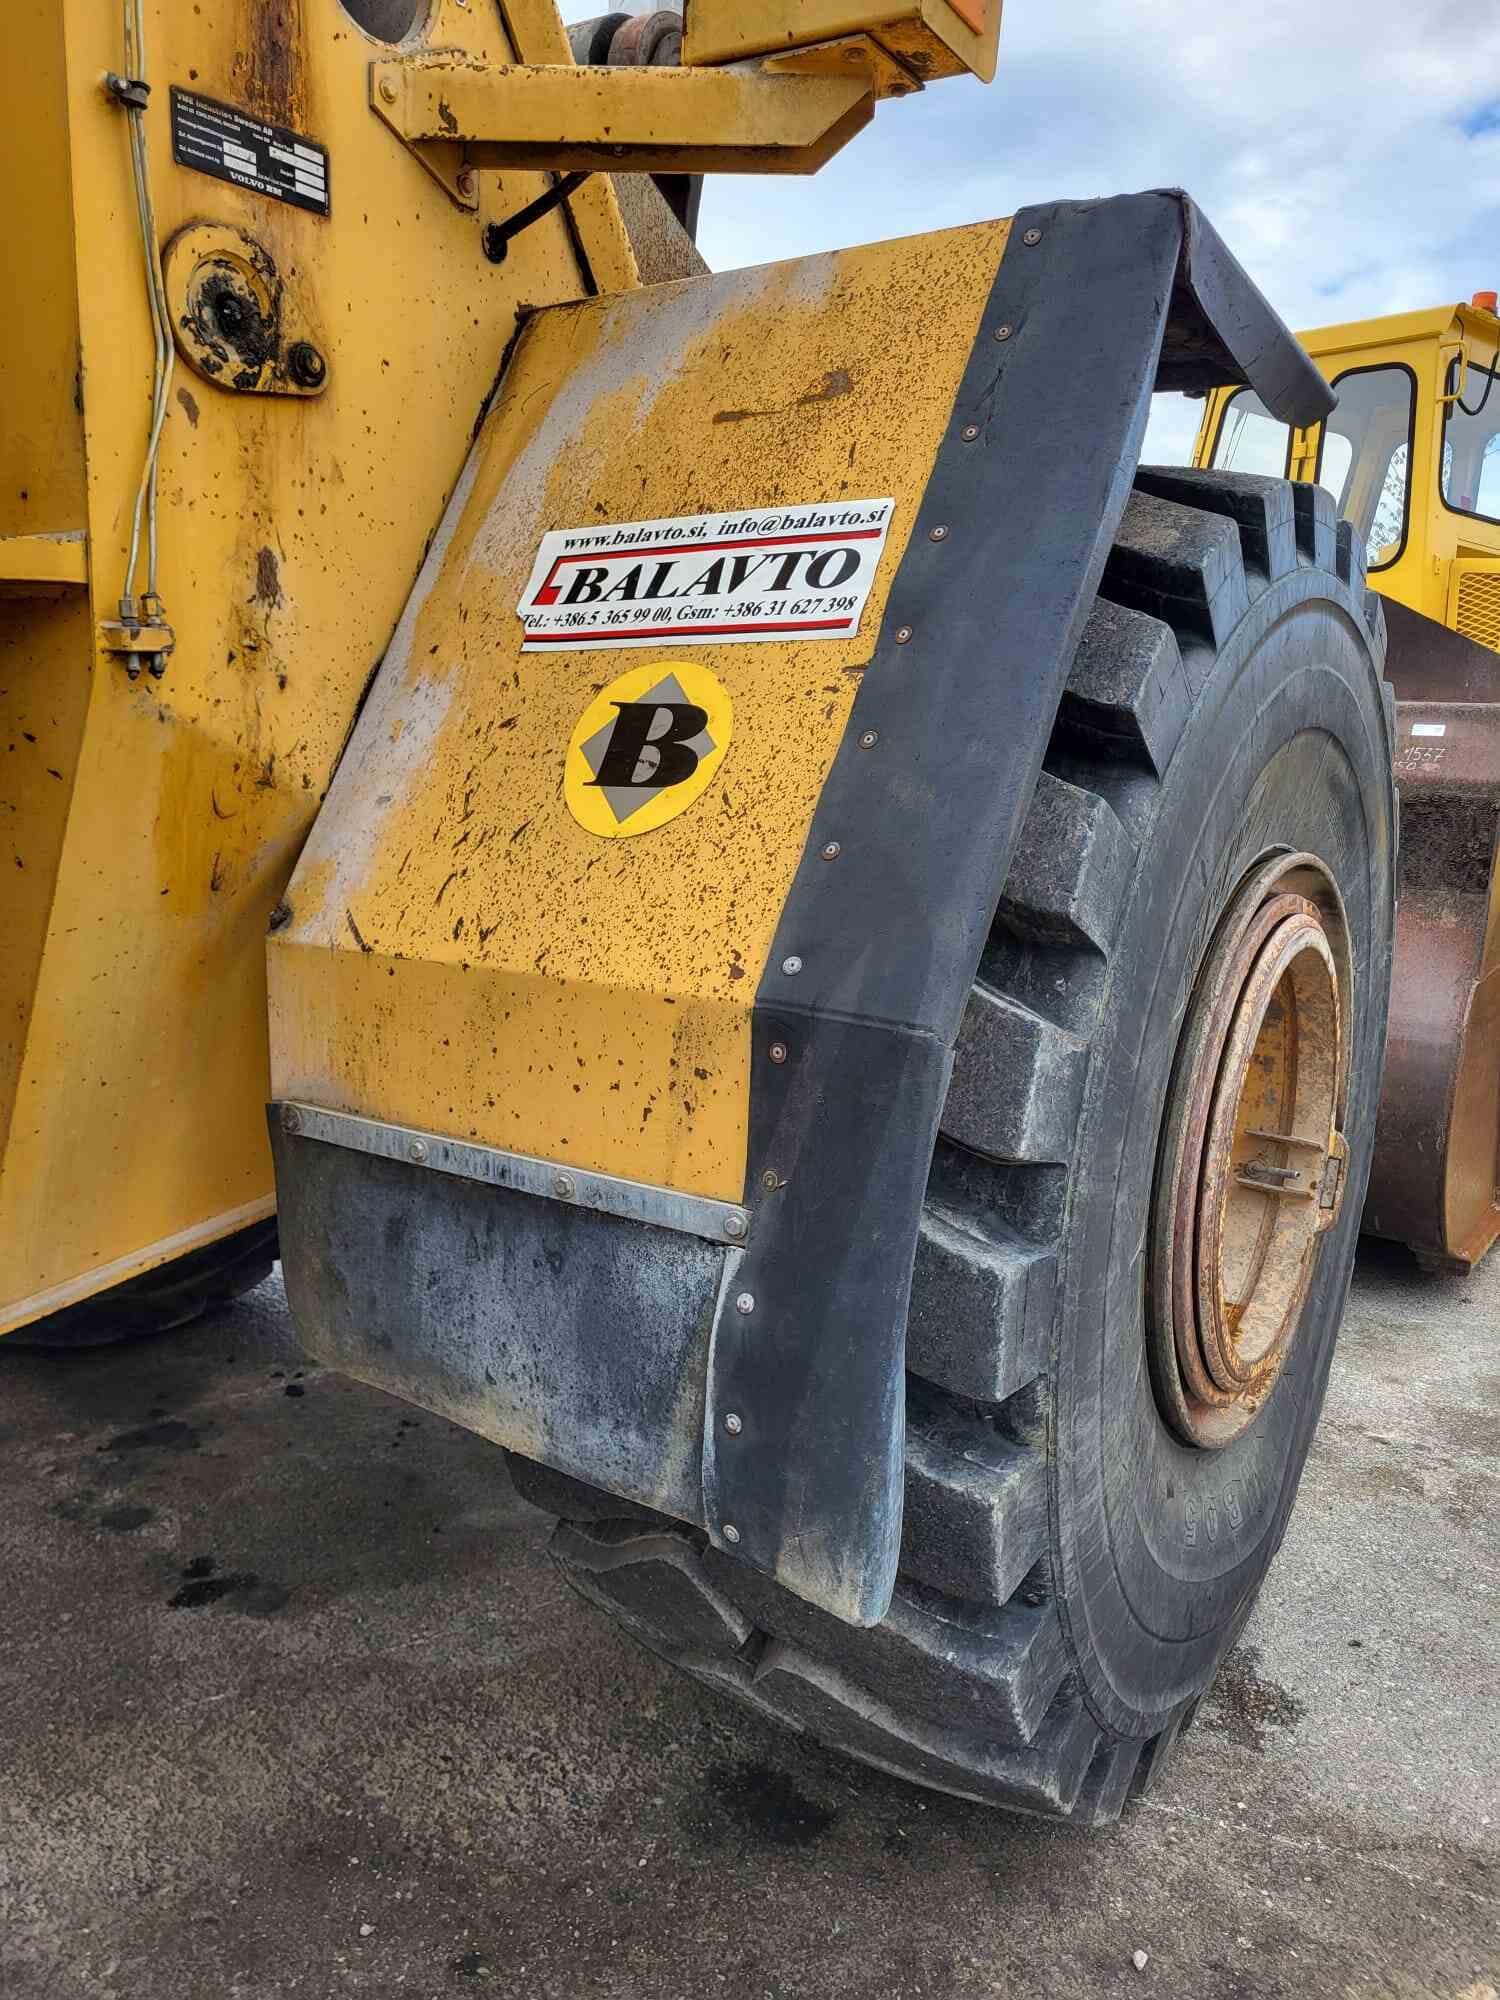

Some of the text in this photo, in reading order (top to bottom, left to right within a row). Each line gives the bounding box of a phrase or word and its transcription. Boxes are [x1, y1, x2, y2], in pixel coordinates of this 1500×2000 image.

[229, 170, 264, 190] VOLVO
[564, 504, 889, 549] www.balavto.si, info@balavto.si
[558, 547, 861, 605] BALAVTO
[553, 611, 585, 628] +386
[587, 610, 600, 625] 5
[601, 609, 630, 625] 365
[633, 607, 651, 623] 99
[652, 606, 673, 623] 00,
[676, 604, 718, 620] Gsm:
[724, 600, 765, 618] +386
[765, 599, 787, 616] 31
[790, 598, 824, 615] 627
[823, 595, 858, 613] 398
[582, 701, 709, 788] B
